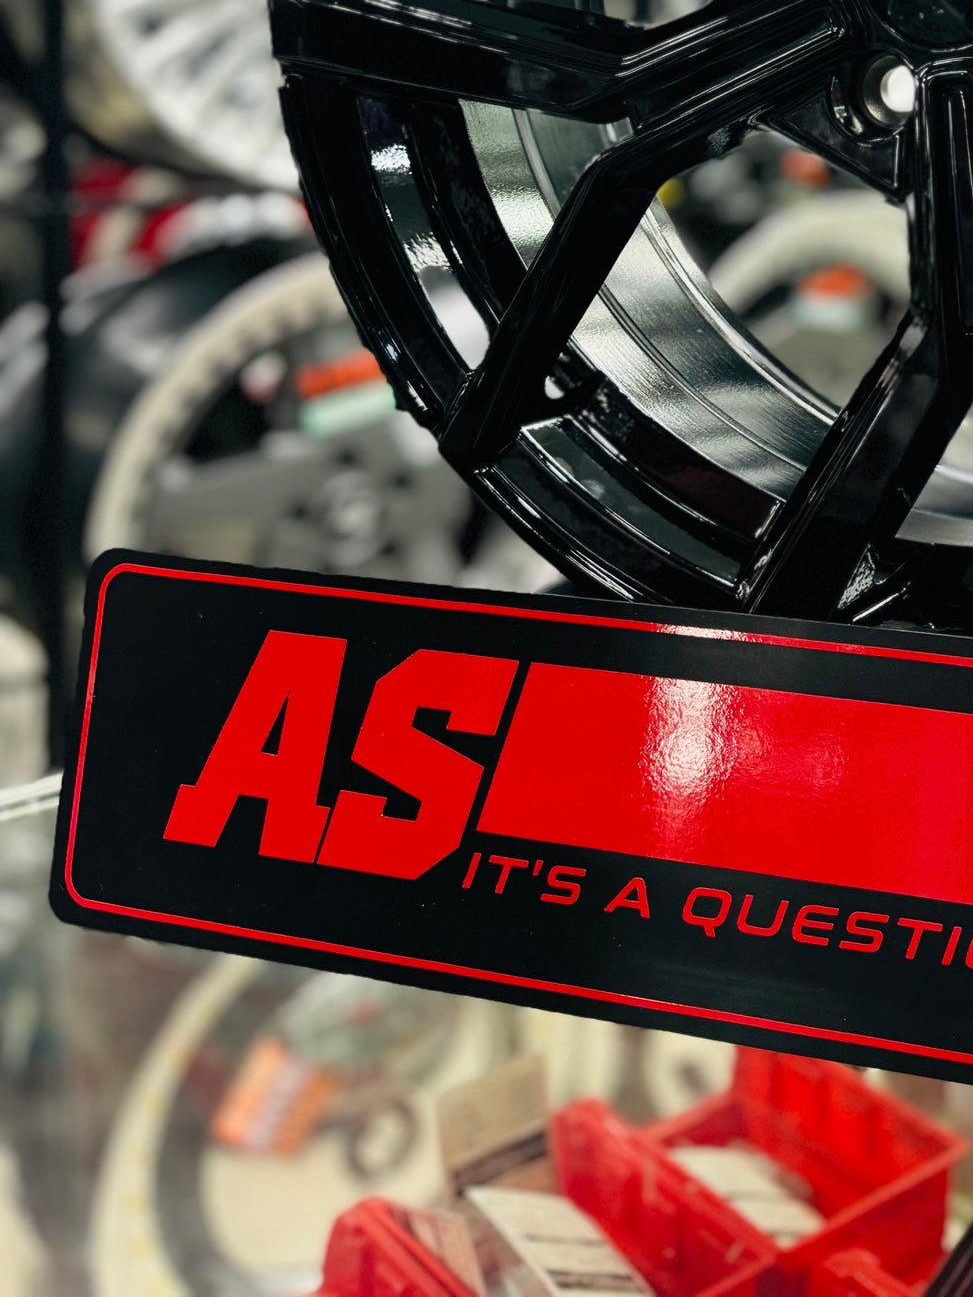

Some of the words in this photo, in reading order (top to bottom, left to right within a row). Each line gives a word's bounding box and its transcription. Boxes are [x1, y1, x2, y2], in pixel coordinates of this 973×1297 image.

[162, 629, 520, 881] AS
[461, 852, 587, 905] IT'S
[604, 877, 650, 919] A
